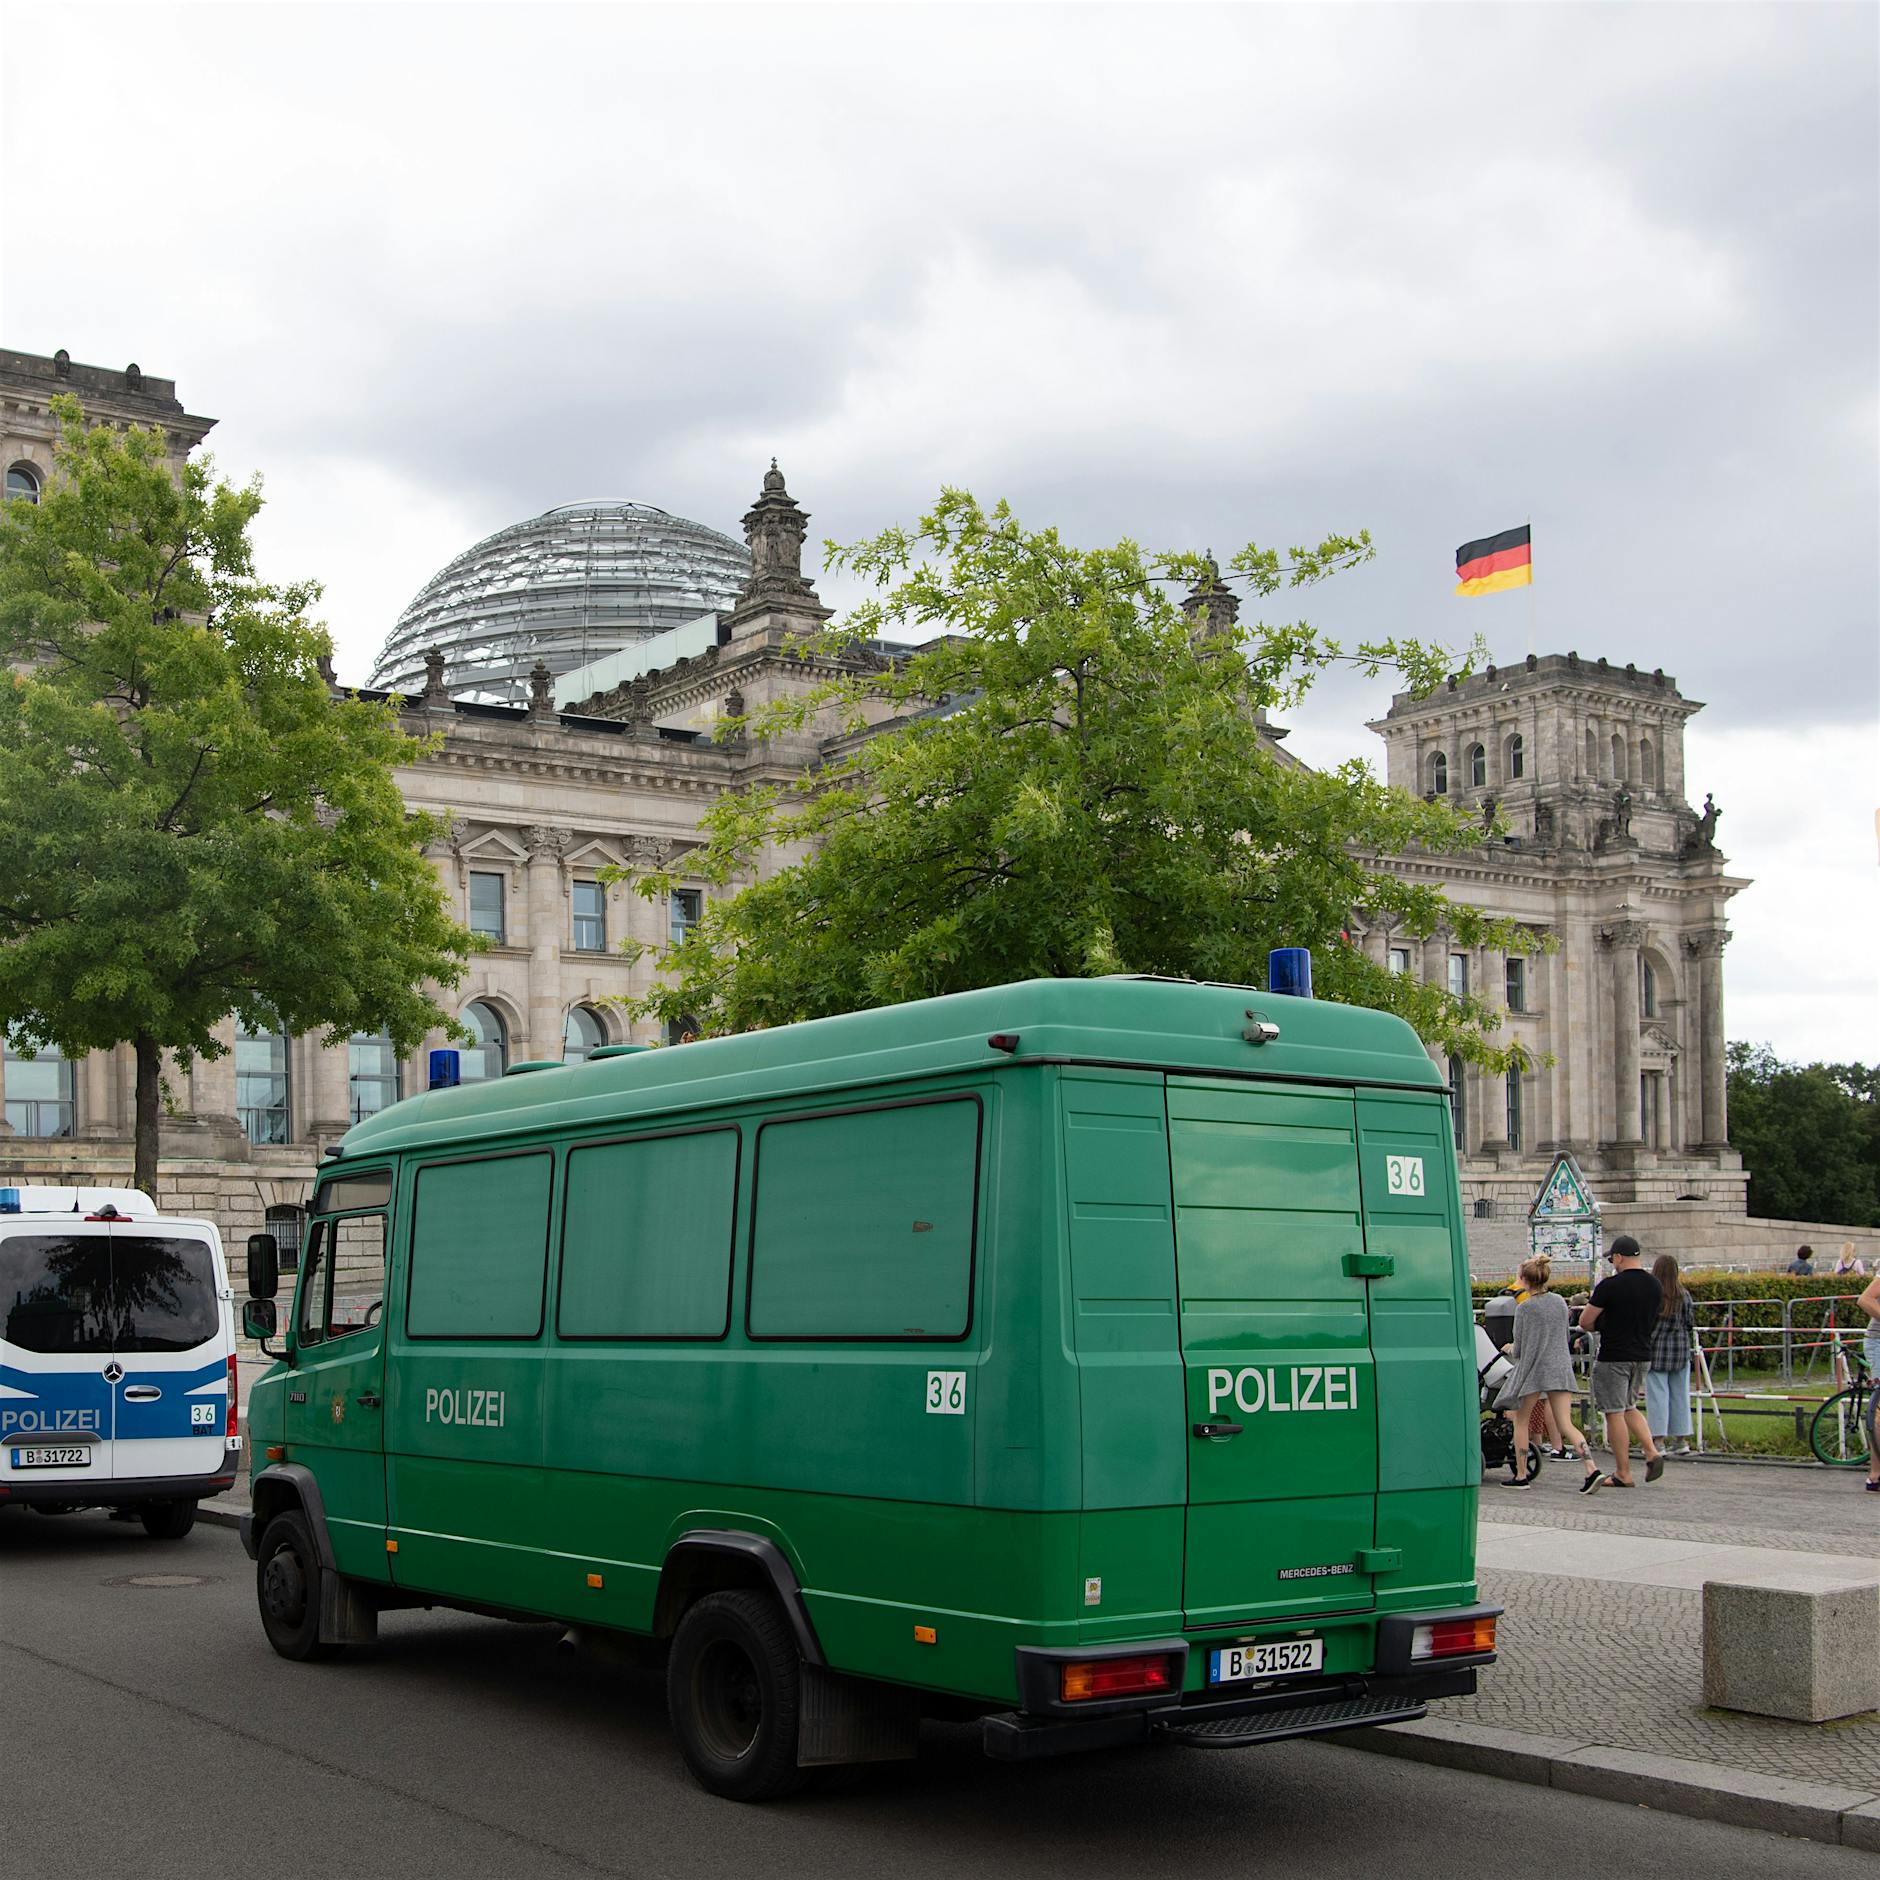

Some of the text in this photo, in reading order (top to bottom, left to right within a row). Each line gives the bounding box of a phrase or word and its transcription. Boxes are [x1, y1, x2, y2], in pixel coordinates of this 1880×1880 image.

[1390, 1160, 1421, 1191] 36
[929, 1376, 962, 1409] 36
[1207, 1366, 1358, 1414] POLIZEI
[1, 1408, 101, 1432] POLIZEI
[193, 1407, 213, 1422] 36
[425, 1388, 505, 1427] POLIZEI
[192, 1426, 213, 1436] BAT
[26, 1449, 83, 1464] B 31722
[1279, 1564, 1354, 1579] MERCEDES-BENZ
[1230, 1651, 1242, 1677] B
[1255, 1643, 1312, 1673] 31522
